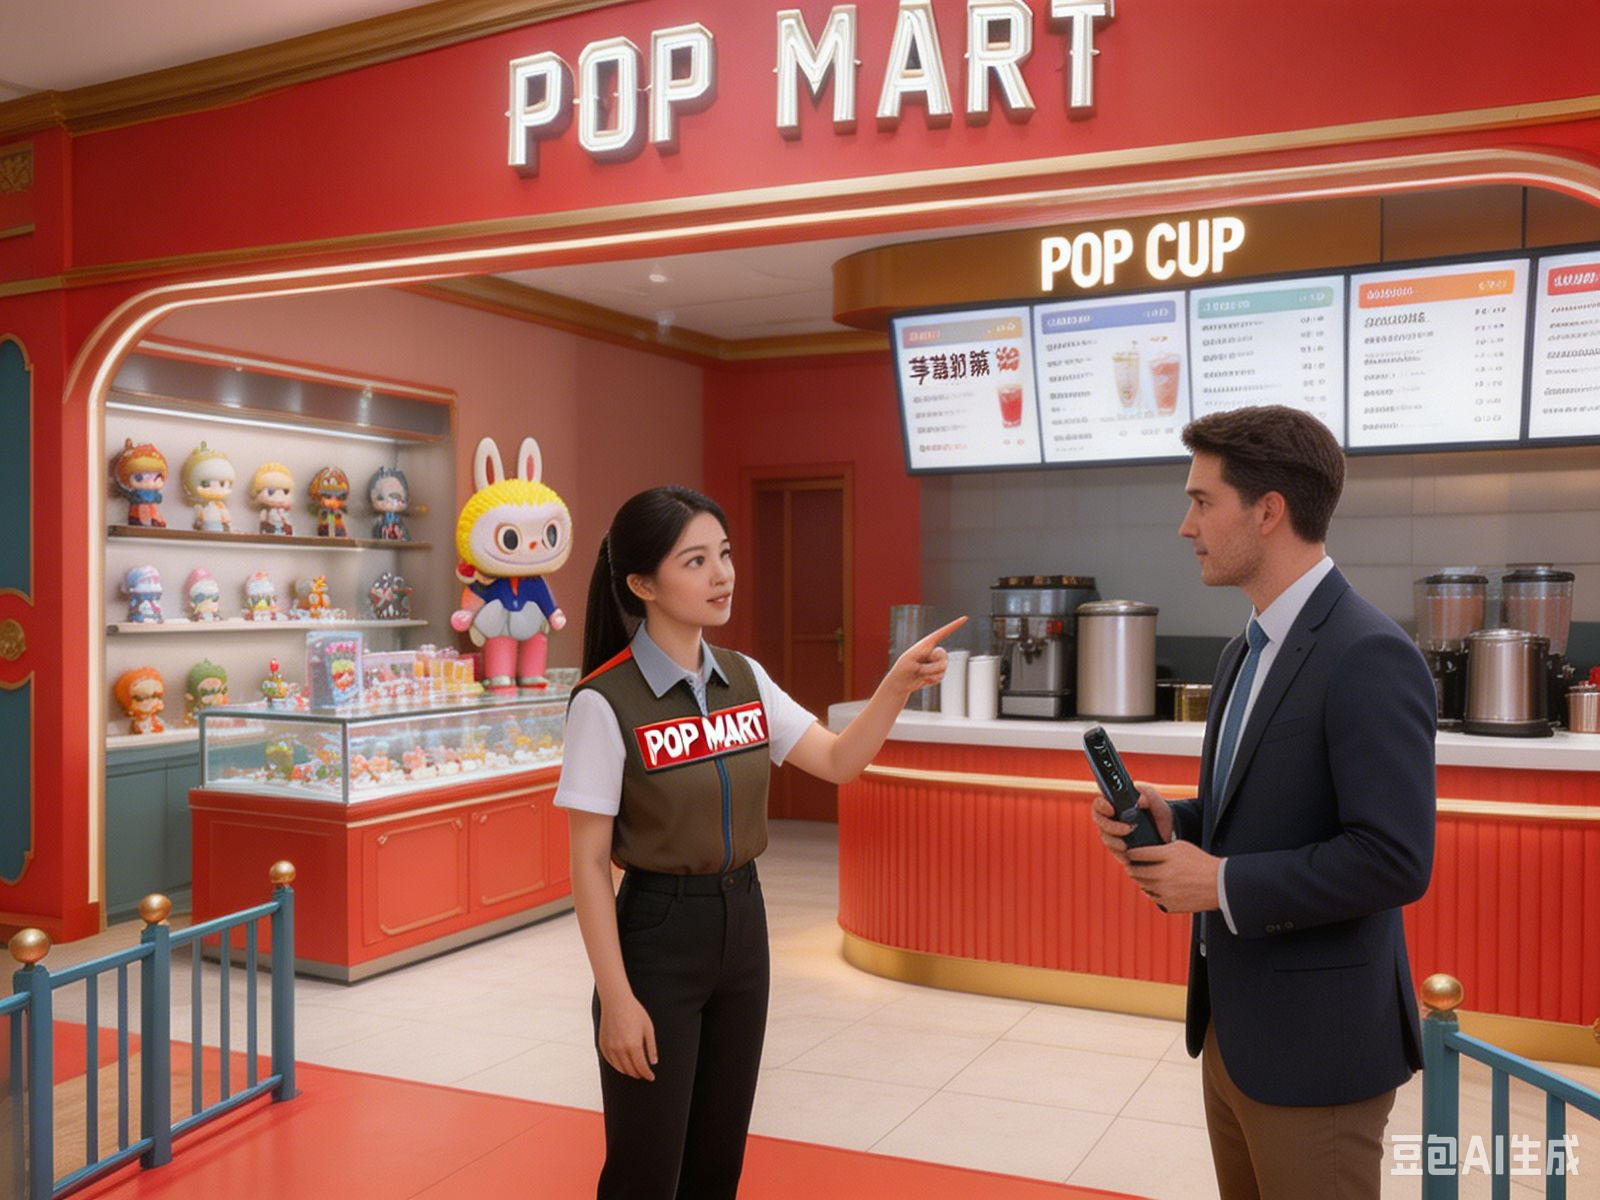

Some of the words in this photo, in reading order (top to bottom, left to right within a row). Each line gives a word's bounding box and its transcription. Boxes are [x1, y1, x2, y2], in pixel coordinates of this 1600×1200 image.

[507, 22, 715, 168] POP
[774, 0, 1115, 131] MART
[1041, 229, 1134, 292] POP
[1145, 216, 1246, 281] CUP
[644, 722, 700, 767] POP
[701, 708, 766, 752] MART
